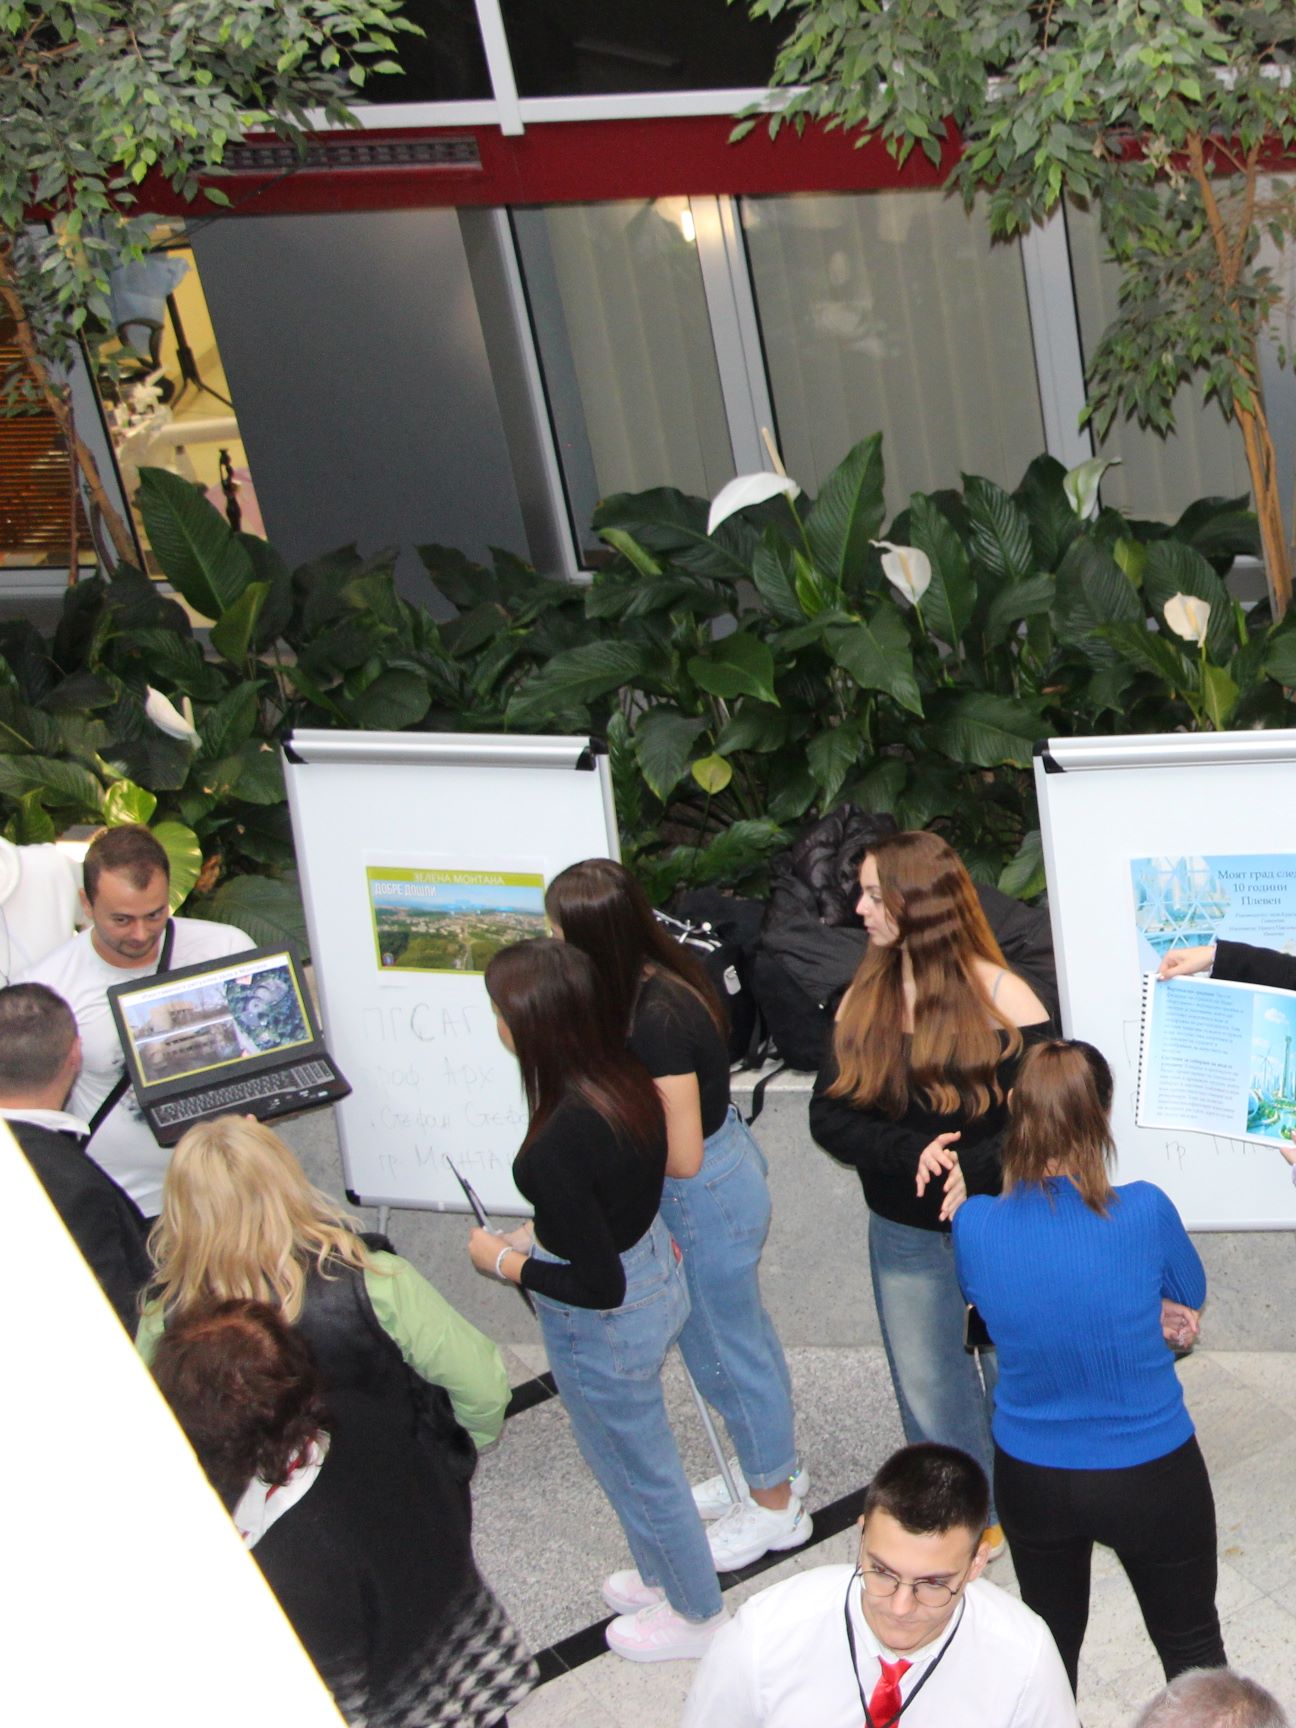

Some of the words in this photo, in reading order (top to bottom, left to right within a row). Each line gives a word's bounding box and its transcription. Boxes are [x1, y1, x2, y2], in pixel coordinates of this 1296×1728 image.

[453, 874, 505, 885] МОНТАНА
[1249, 871, 1274, 880] град
[375, 883, 402, 895] ДОБРЕ
[1233, 883, 1245, 892] 10
[1247, 884, 1287, 892] години
[1241, 896, 1281, 905] Плевен
